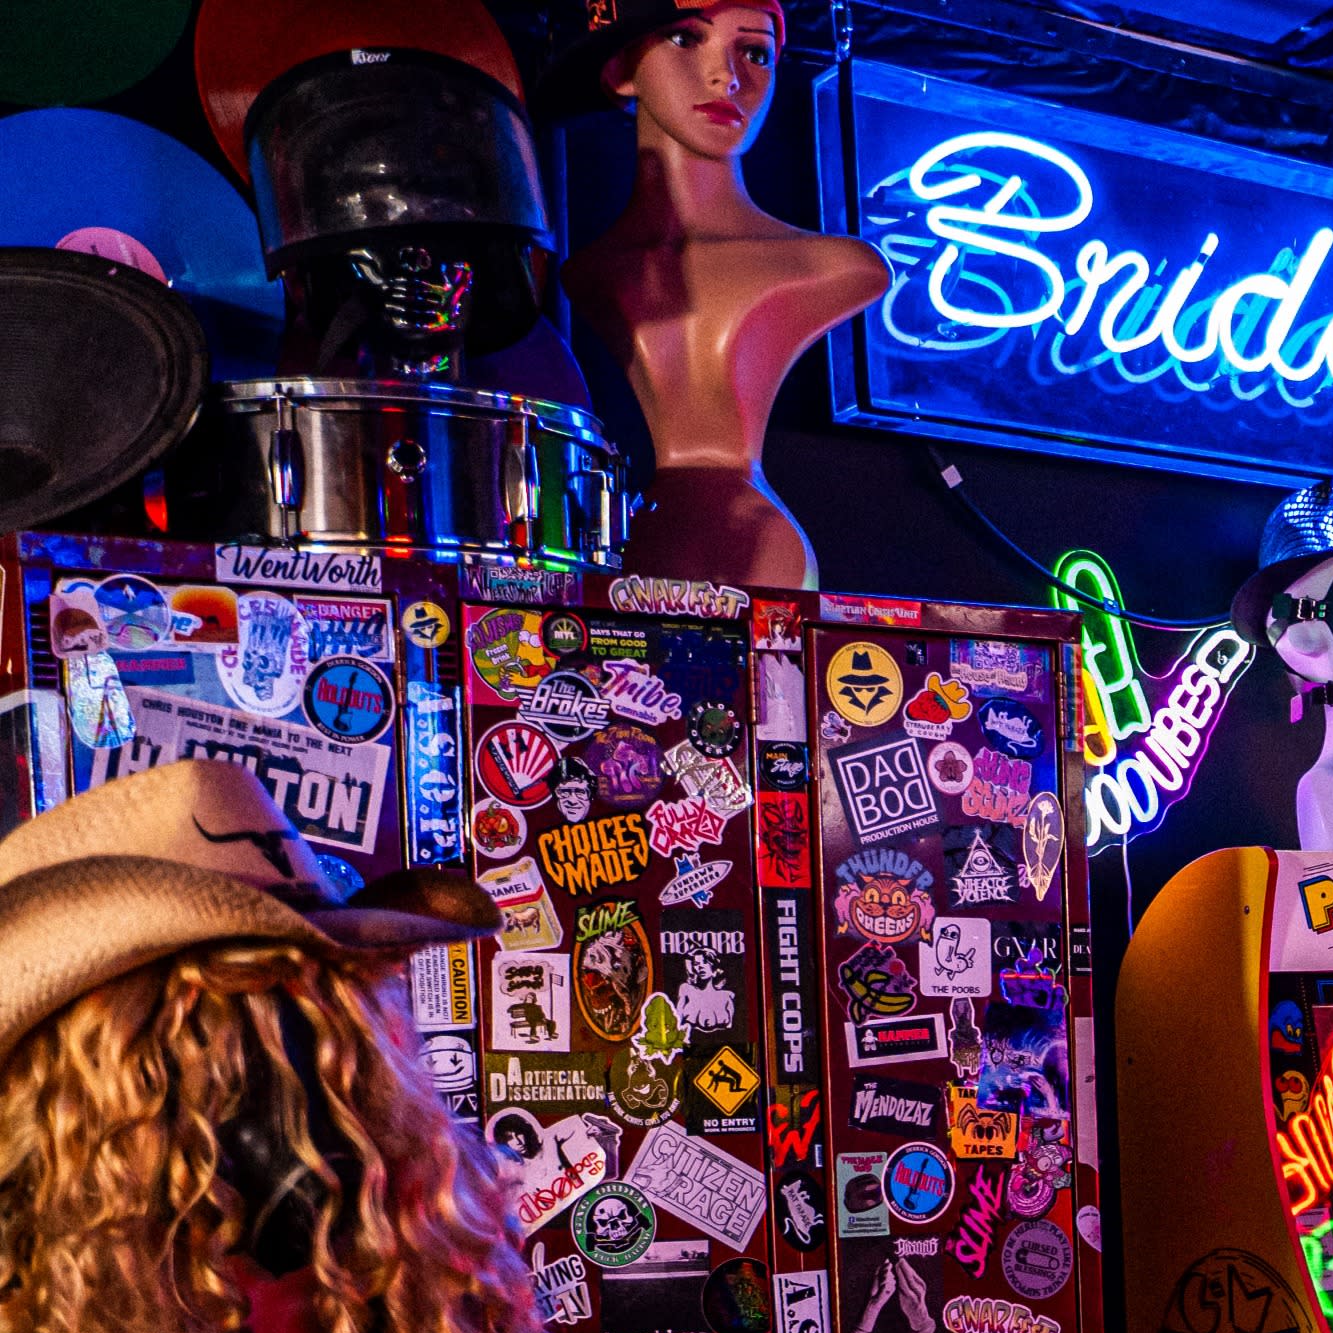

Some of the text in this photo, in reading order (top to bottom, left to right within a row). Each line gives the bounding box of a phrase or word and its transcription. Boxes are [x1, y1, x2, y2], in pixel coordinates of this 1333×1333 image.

[550, 680, 576, 697] The
[530, 690, 611, 722] Brokes
[860, 814, 940, 845] PRODUCTION HOUSE
[541, 813, 648, 888] CHOICES
[563, 847, 646, 896] MADE
[836, 848, 934, 890] THUNDER
[451, 957, 469, 1022] CAUTION
[776, 899, 804, 1073] FIGHT COPS
[931, 985, 981, 995] THE POOBS
[703, 1117, 756, 1128] NO ENTRY
[963, 1143, 1004, 1157] TAPES
